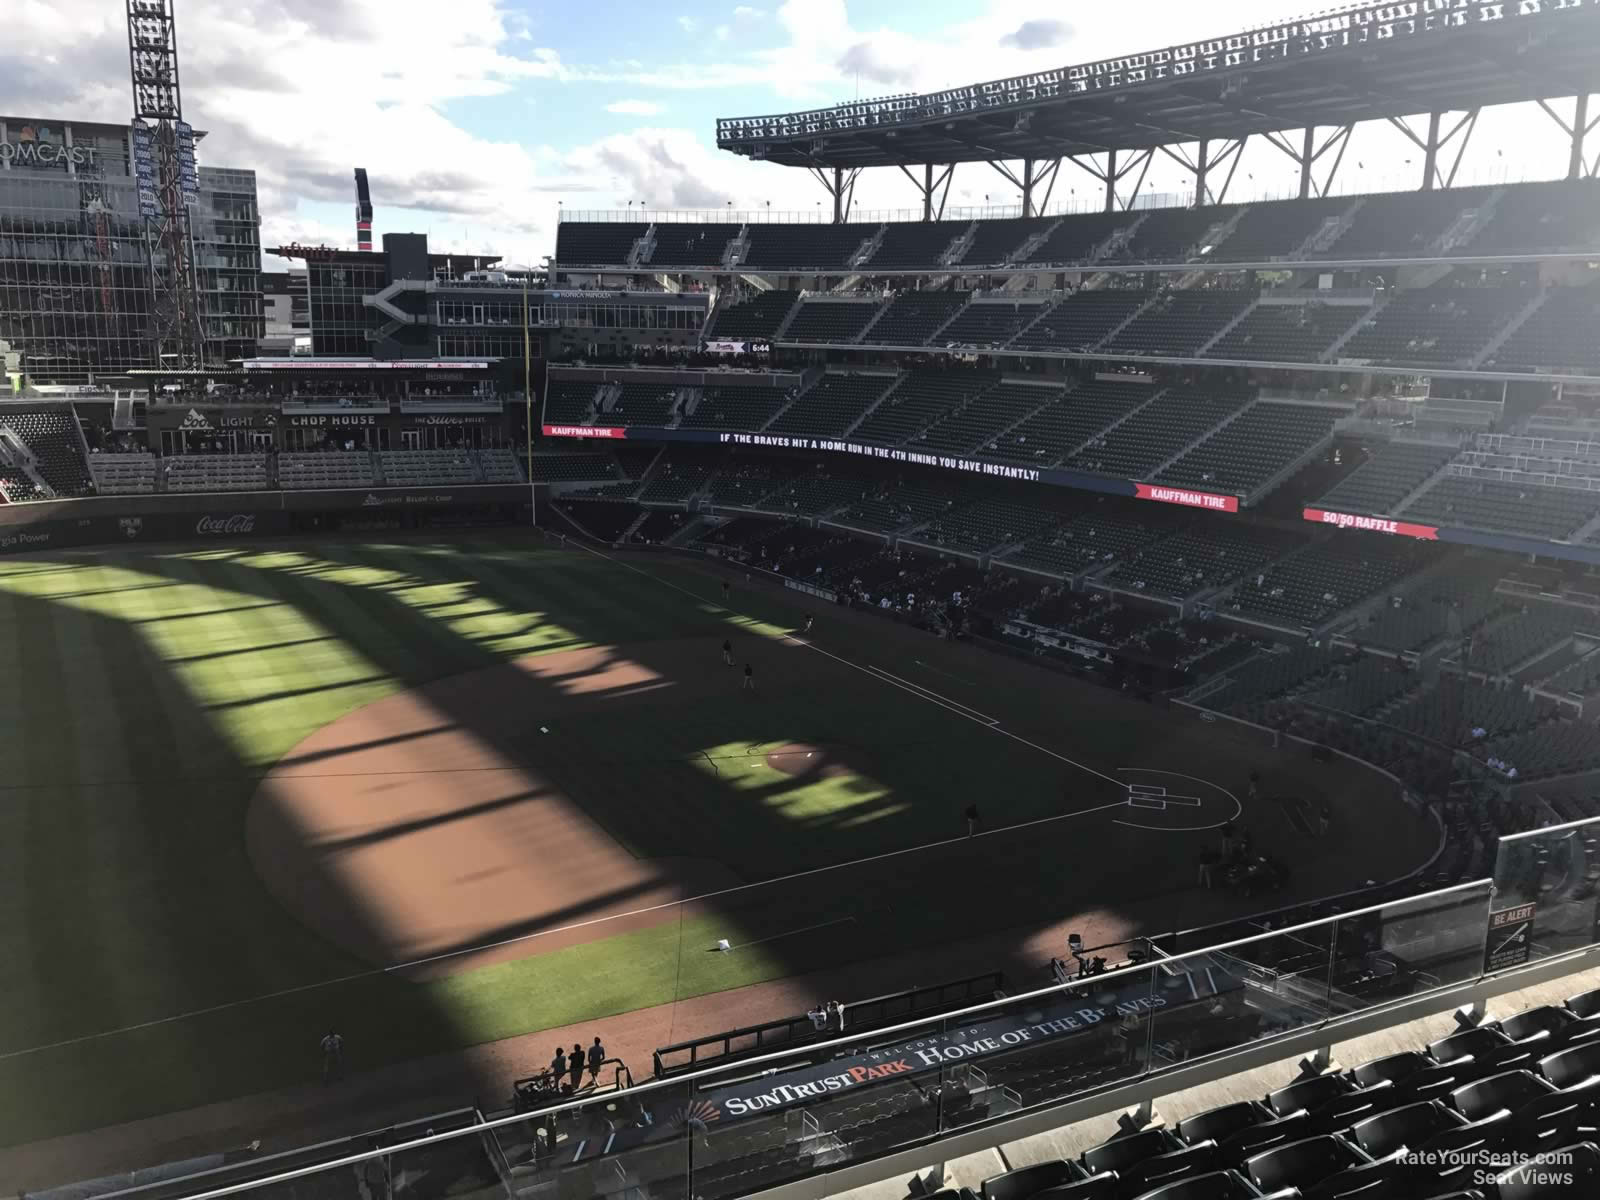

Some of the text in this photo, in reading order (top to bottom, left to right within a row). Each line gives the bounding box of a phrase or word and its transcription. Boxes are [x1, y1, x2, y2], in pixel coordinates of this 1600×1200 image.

[752, 344, 770, 352] 6:44
[220, 417, 254, 427] LIGHT
[291, 415, 375, 426] CHOP HOUSE
[551, 426, 612, 437] KAUFFMAN TIRE
[720, 433, 1039, 481] IF THE BRAVES HIT A HOME RUN IN THE 4TH INNING YOU SAVE INSTANTLY!
[1151, 488, 1226, 508] KAUFFMAN TIRE
[1323, 511, 1398, 533] 50/50 RAFFLE
[19, 533, 50, 544] Power
[1494, 906, 1533, 926] BE ALERT
[914, 1037, 1001, 1066] HOME
[1000, 1026, 1032, 1047] OF
[1031, 1014, 1083, 1039] THE
